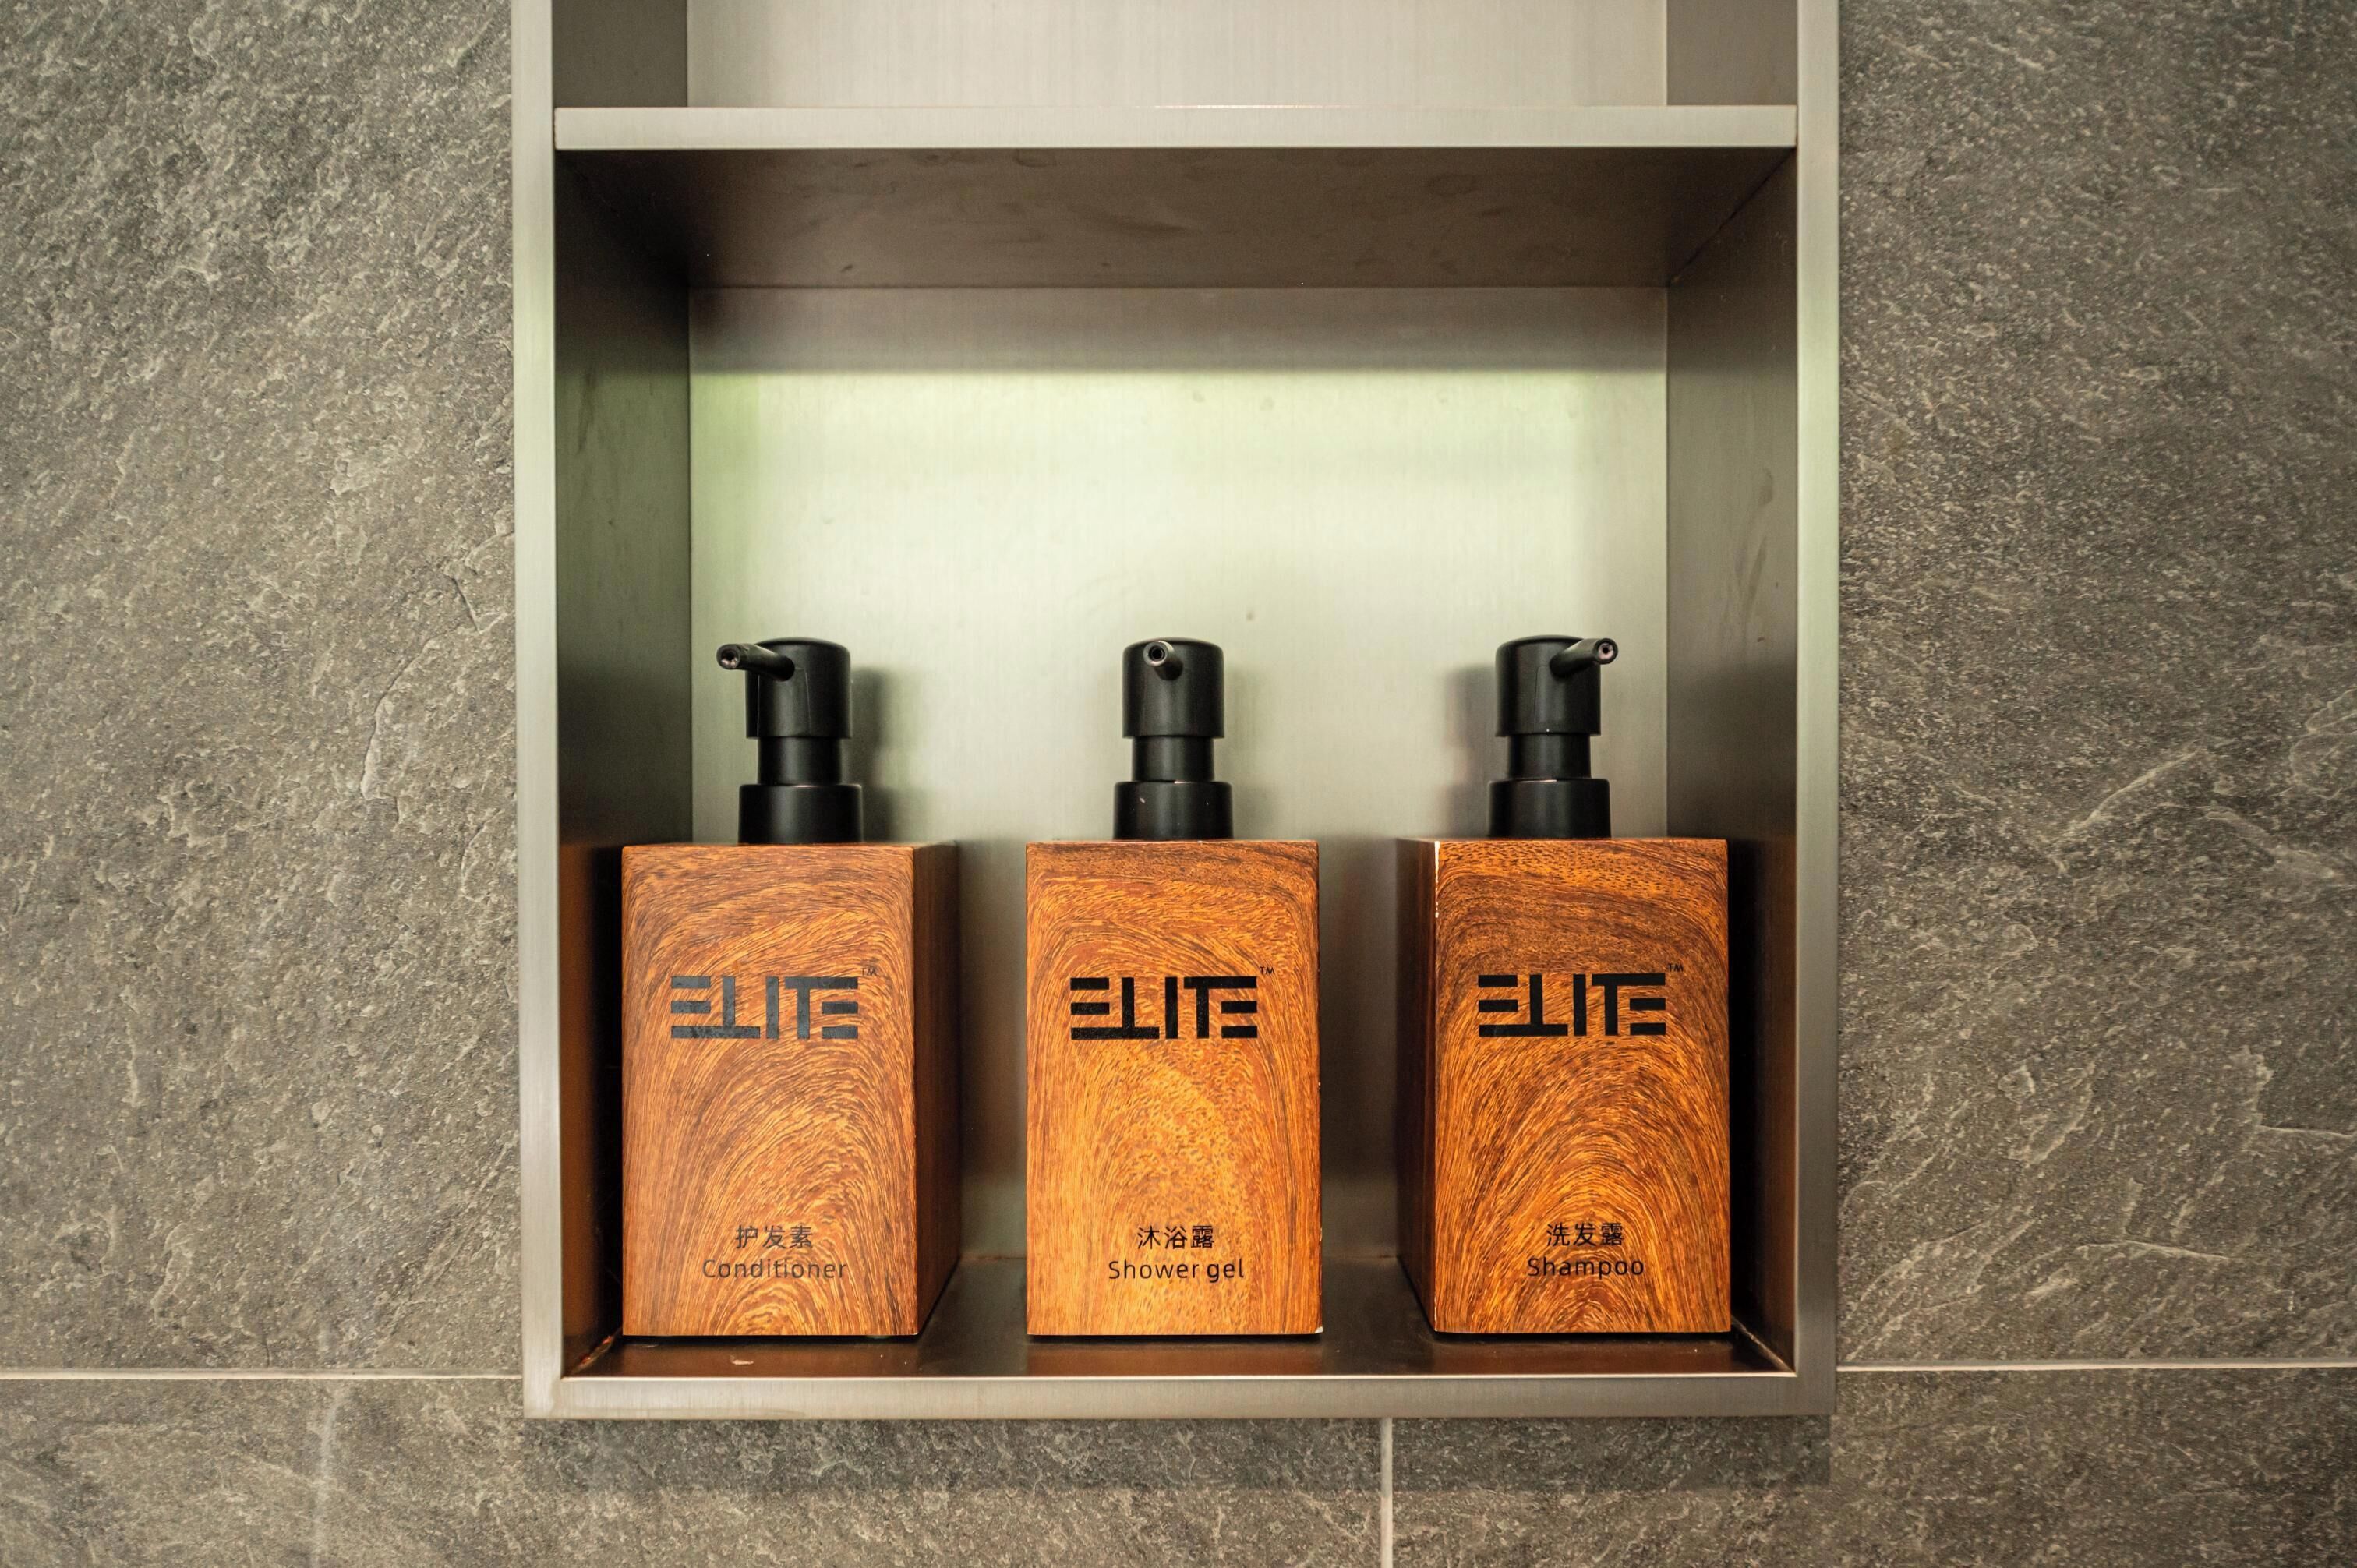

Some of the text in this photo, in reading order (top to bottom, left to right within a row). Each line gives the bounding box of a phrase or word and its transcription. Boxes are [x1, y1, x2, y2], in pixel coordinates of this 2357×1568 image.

[736, 1224, 813, 1249] 护发素
[1137, 1225, 1215, 1250] 沐浴露
[1546, 1222, 1624, 1247] 洗发露
[702, 1259, 846, 1279] Conditioner
[1108, 1258, 1245, 1284] Shower gel
[1528, 1256, 1645, 1280] Shampoo
